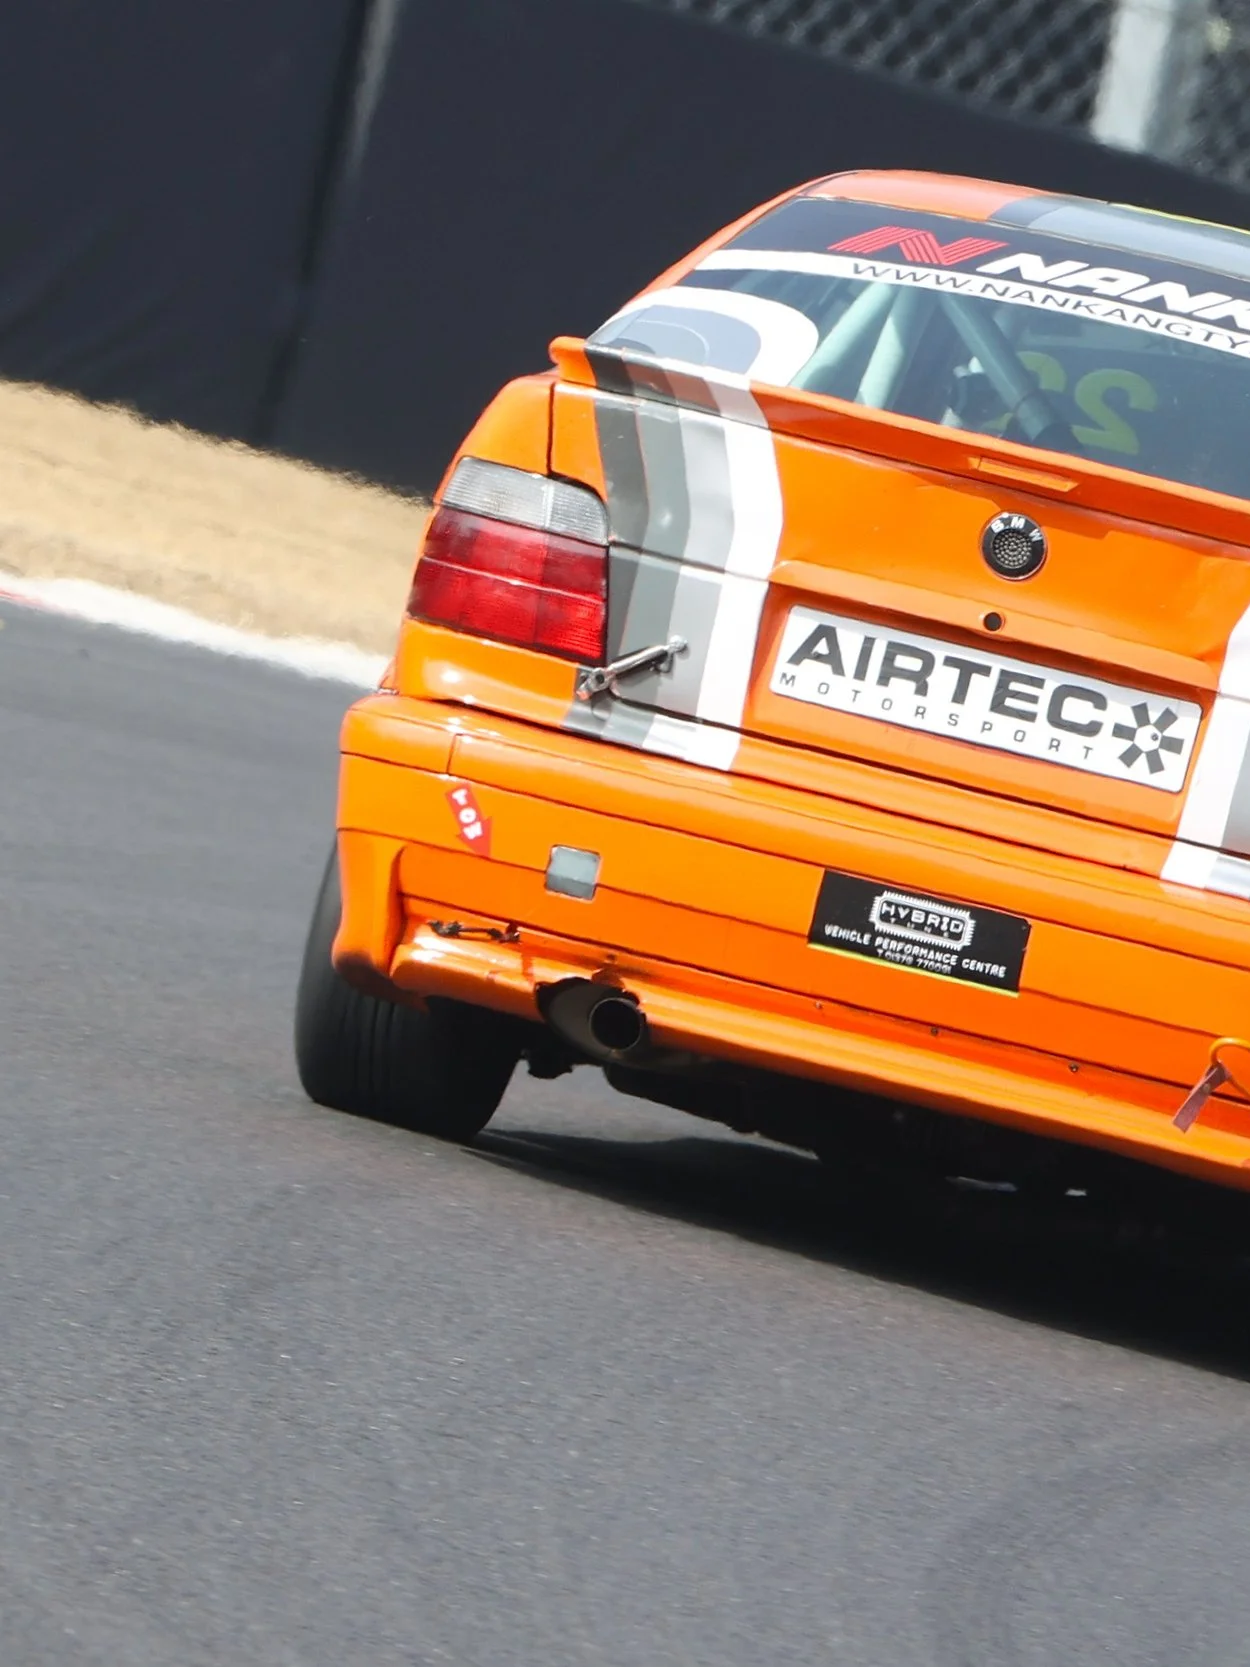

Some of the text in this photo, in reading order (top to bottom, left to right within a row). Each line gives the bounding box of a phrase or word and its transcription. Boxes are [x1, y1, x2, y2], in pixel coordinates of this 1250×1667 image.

[991, 516, 1043, 542] BMW
[786, 623, 1109, 738] AIRTEC
[780, 671, 1094, 761] MOTORSPORT
[451, 788, 483, 840] TOW
[881, 902, 964, 934] HYBRID
[824, 923, 1007, 978] VEHICLE PERFORMANCE CENTRE
